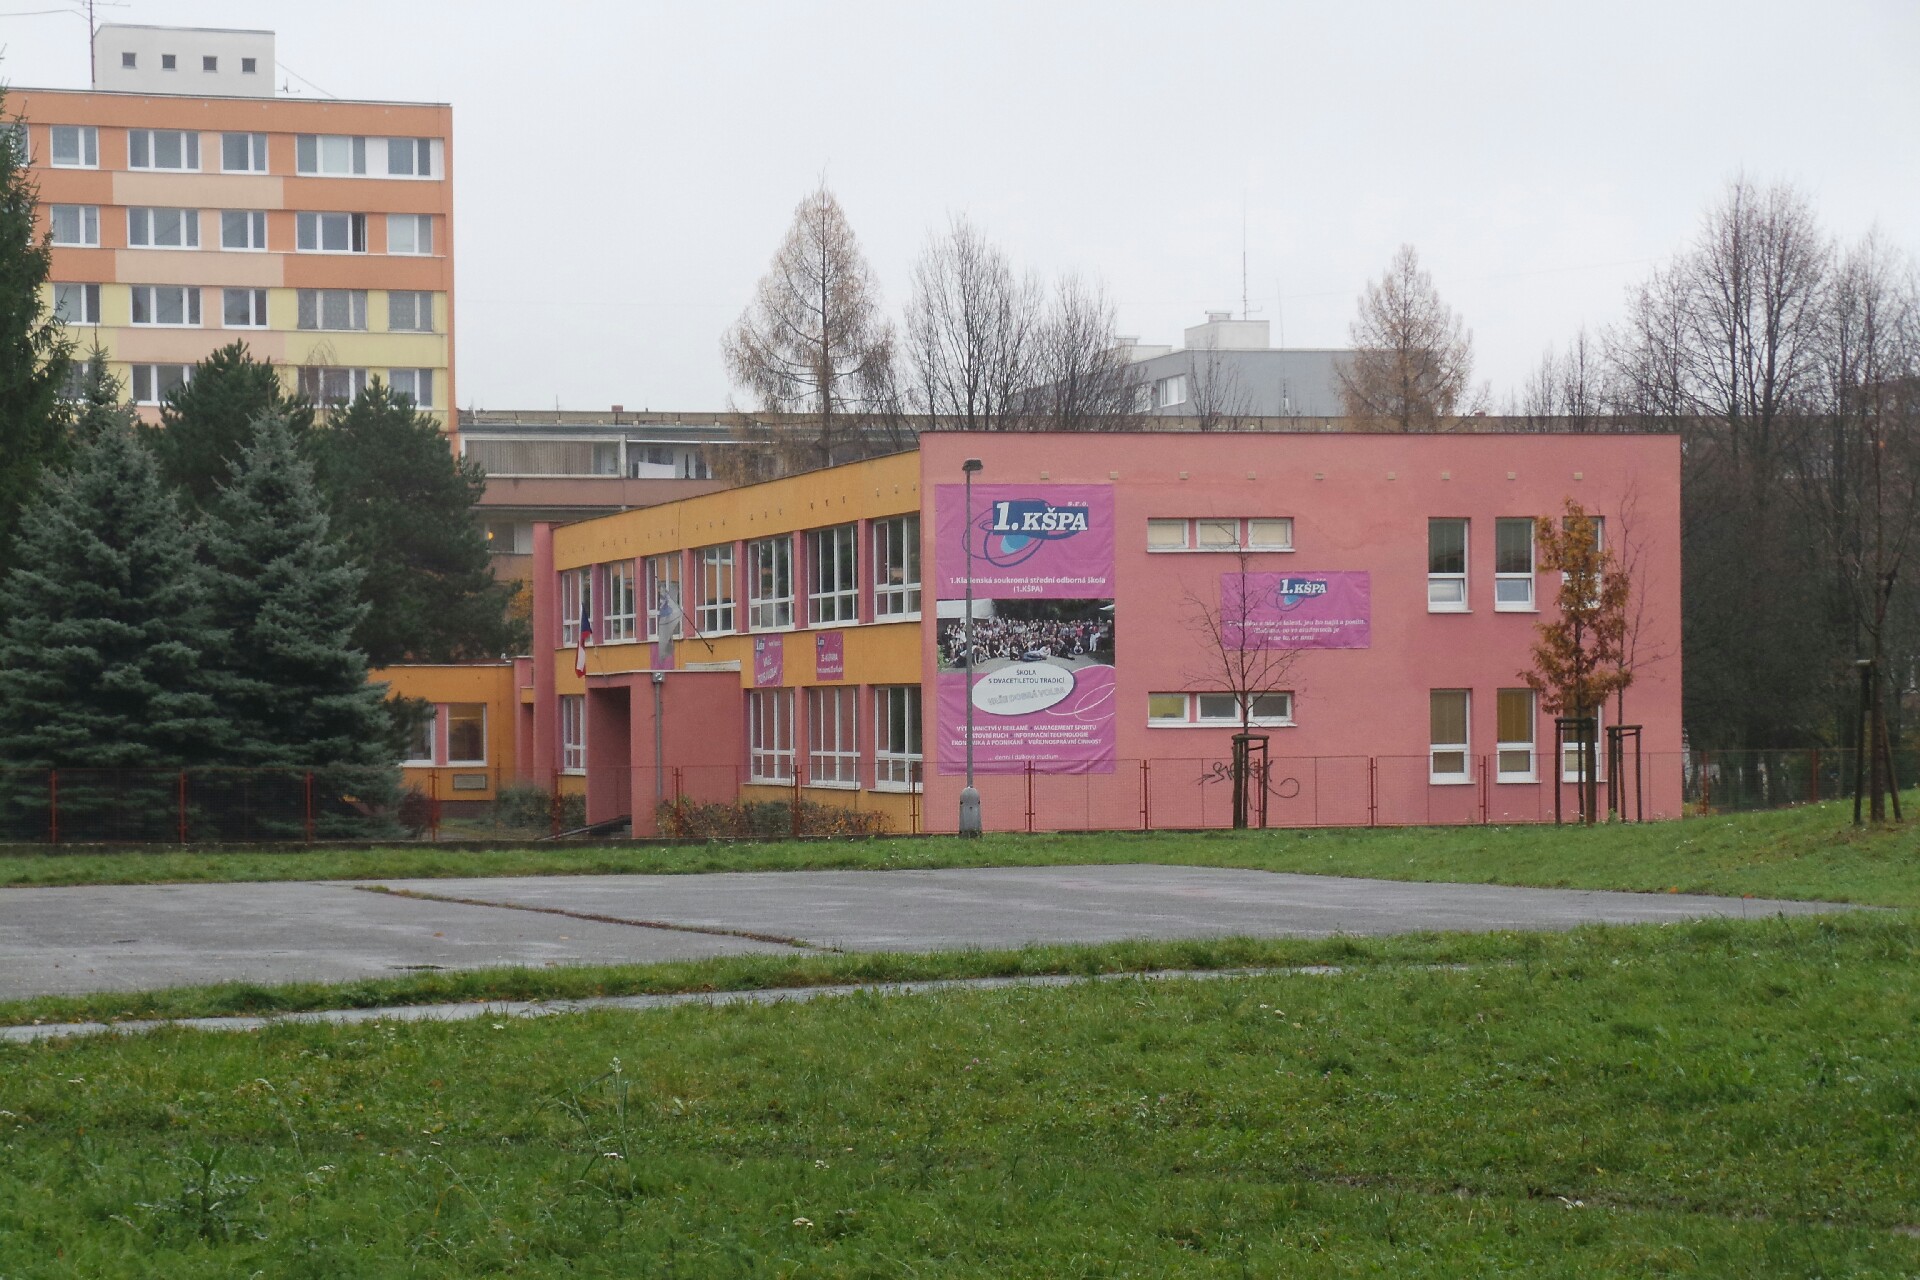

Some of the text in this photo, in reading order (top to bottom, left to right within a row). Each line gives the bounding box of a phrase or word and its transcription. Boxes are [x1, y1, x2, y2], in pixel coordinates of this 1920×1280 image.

[993, 576, 1028, 584] soukromá
[1030, 576, 1055, 584] střední
[1056, 576, 1086, 584] odborná
[1087, 576, 1106, 584] škola
[1013, 585, 1044, 593] (1.KŠPA)
[1040, 676, 1065, 684] TRADICÍ
